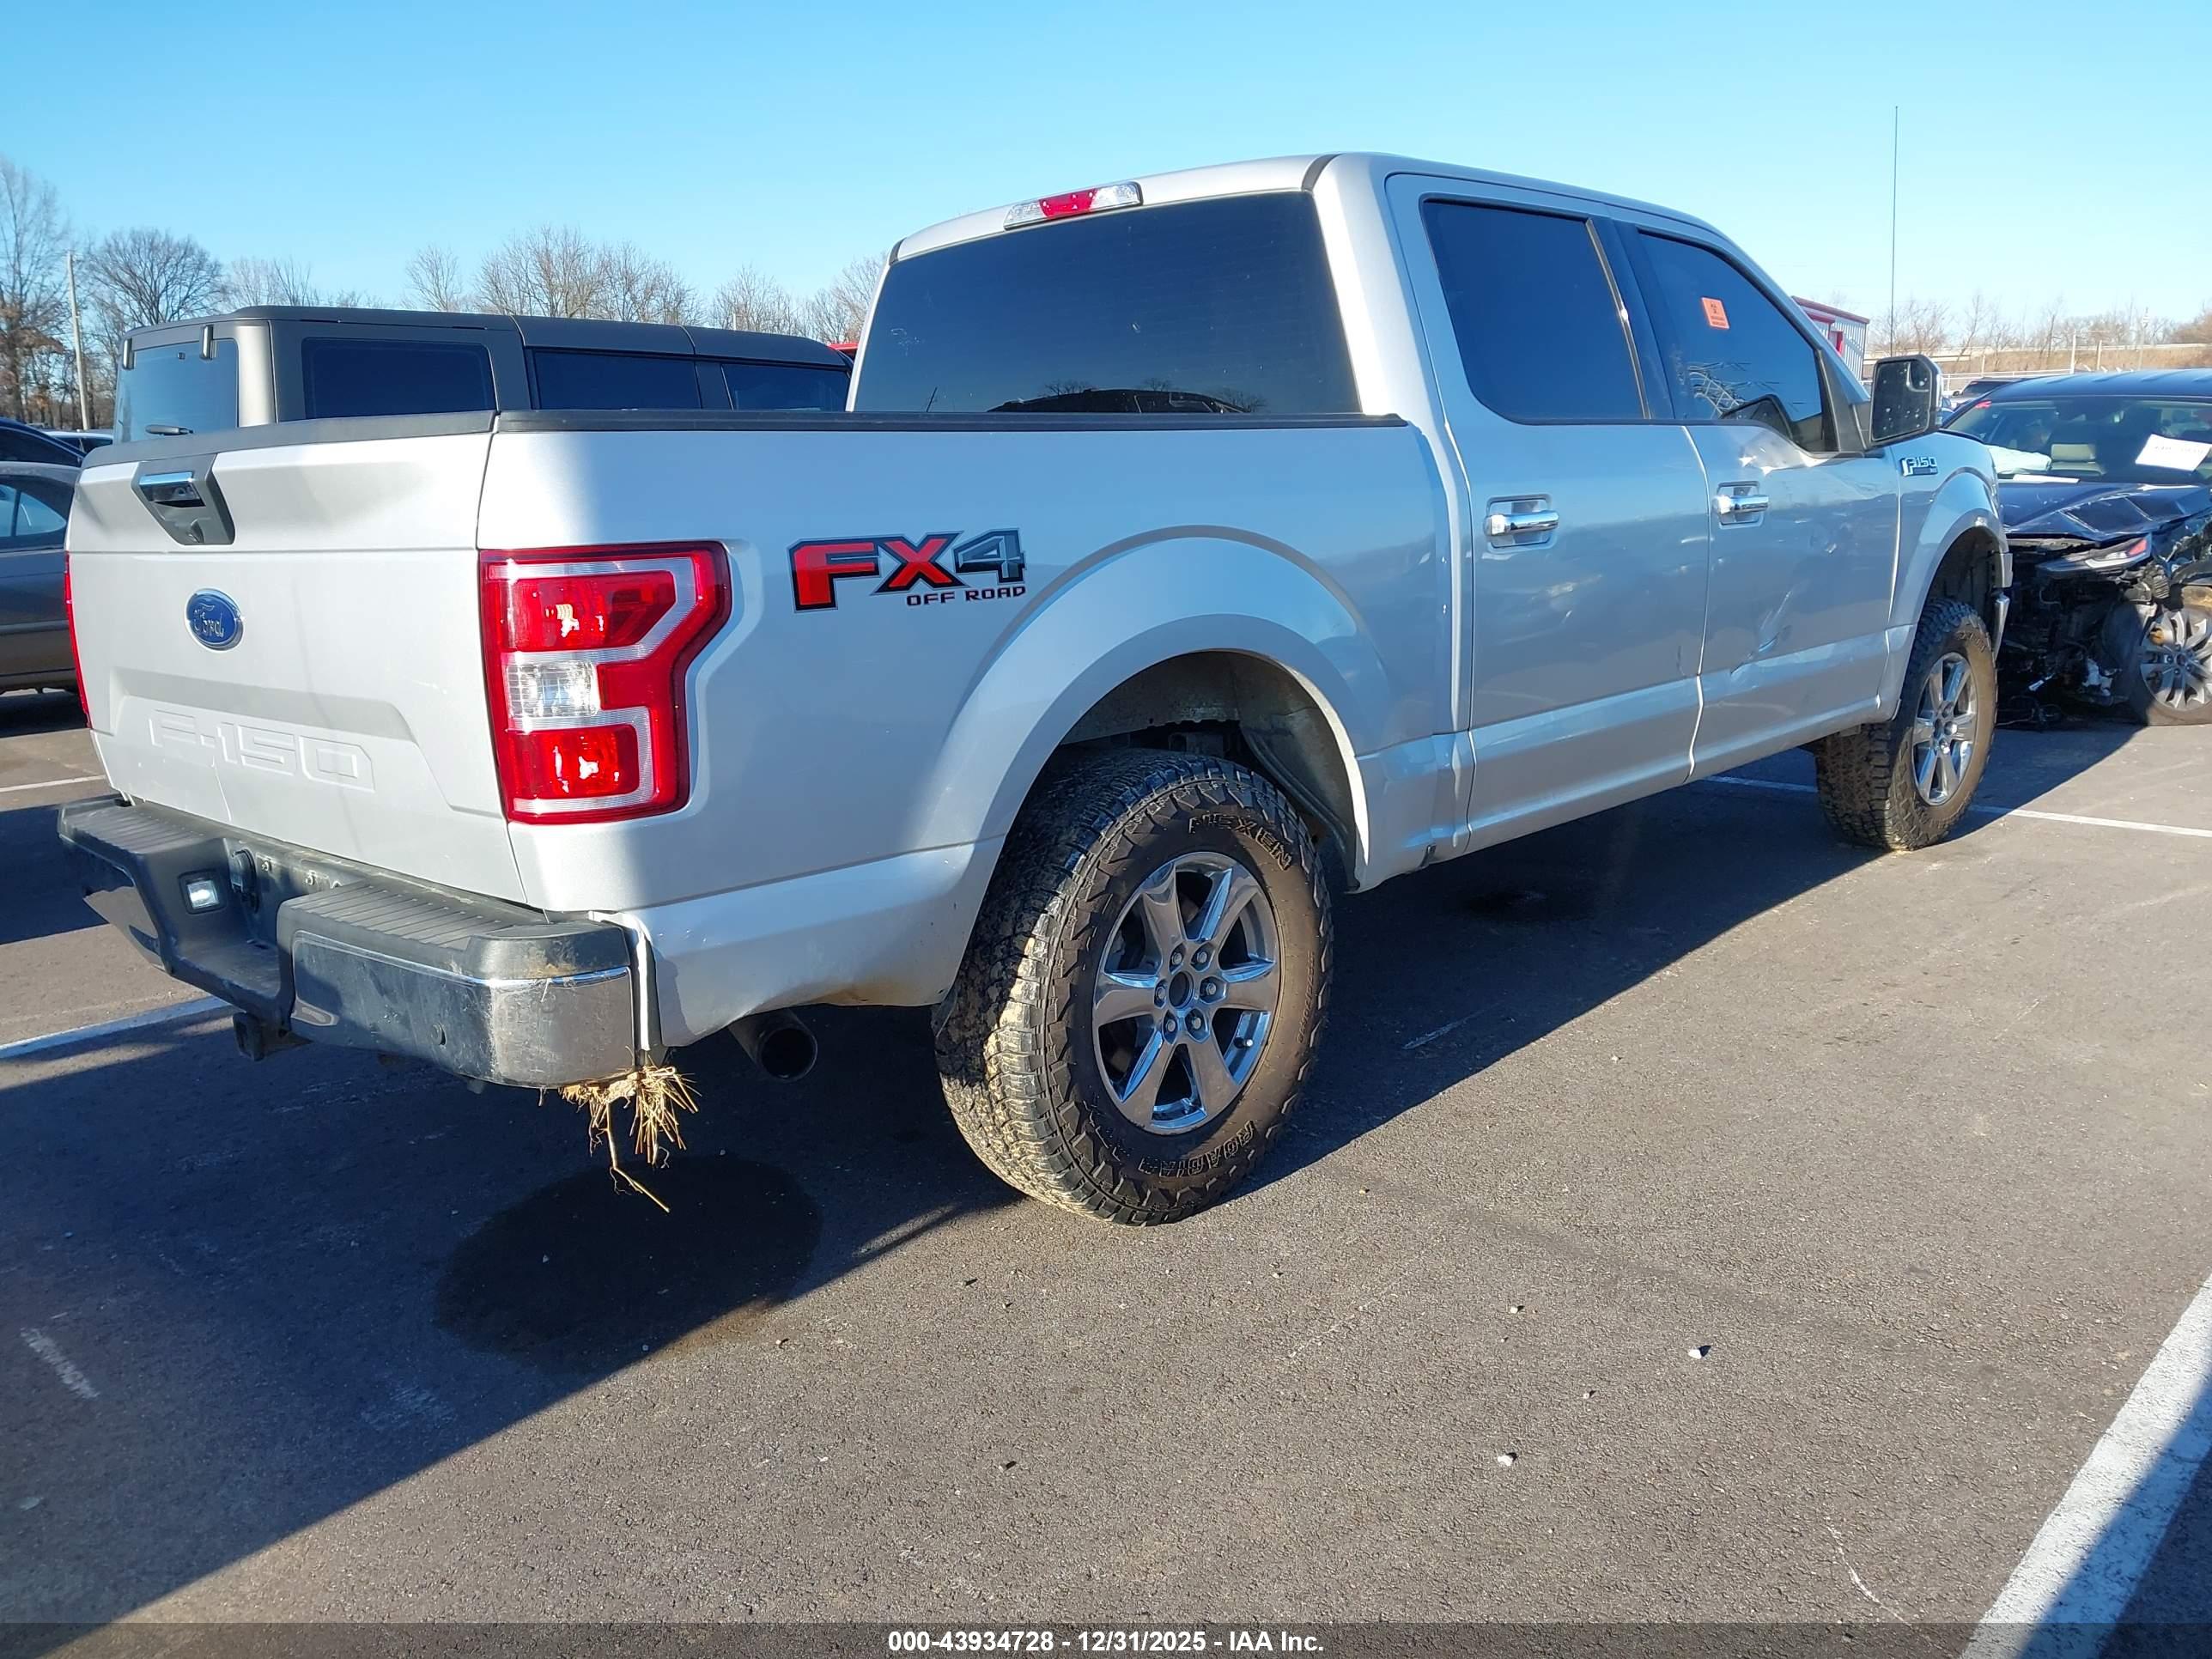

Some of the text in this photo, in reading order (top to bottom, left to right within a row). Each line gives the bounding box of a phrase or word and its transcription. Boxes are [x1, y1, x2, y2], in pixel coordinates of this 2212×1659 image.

[787, 528, 1027, 613] FX4
[906, 586, 1027, 606] OFF ROAD
[192, 602, 226, 638] Ford
[149, 709, 376, 793] F-150
[1188, 813, 1292, 872] NEXEN
